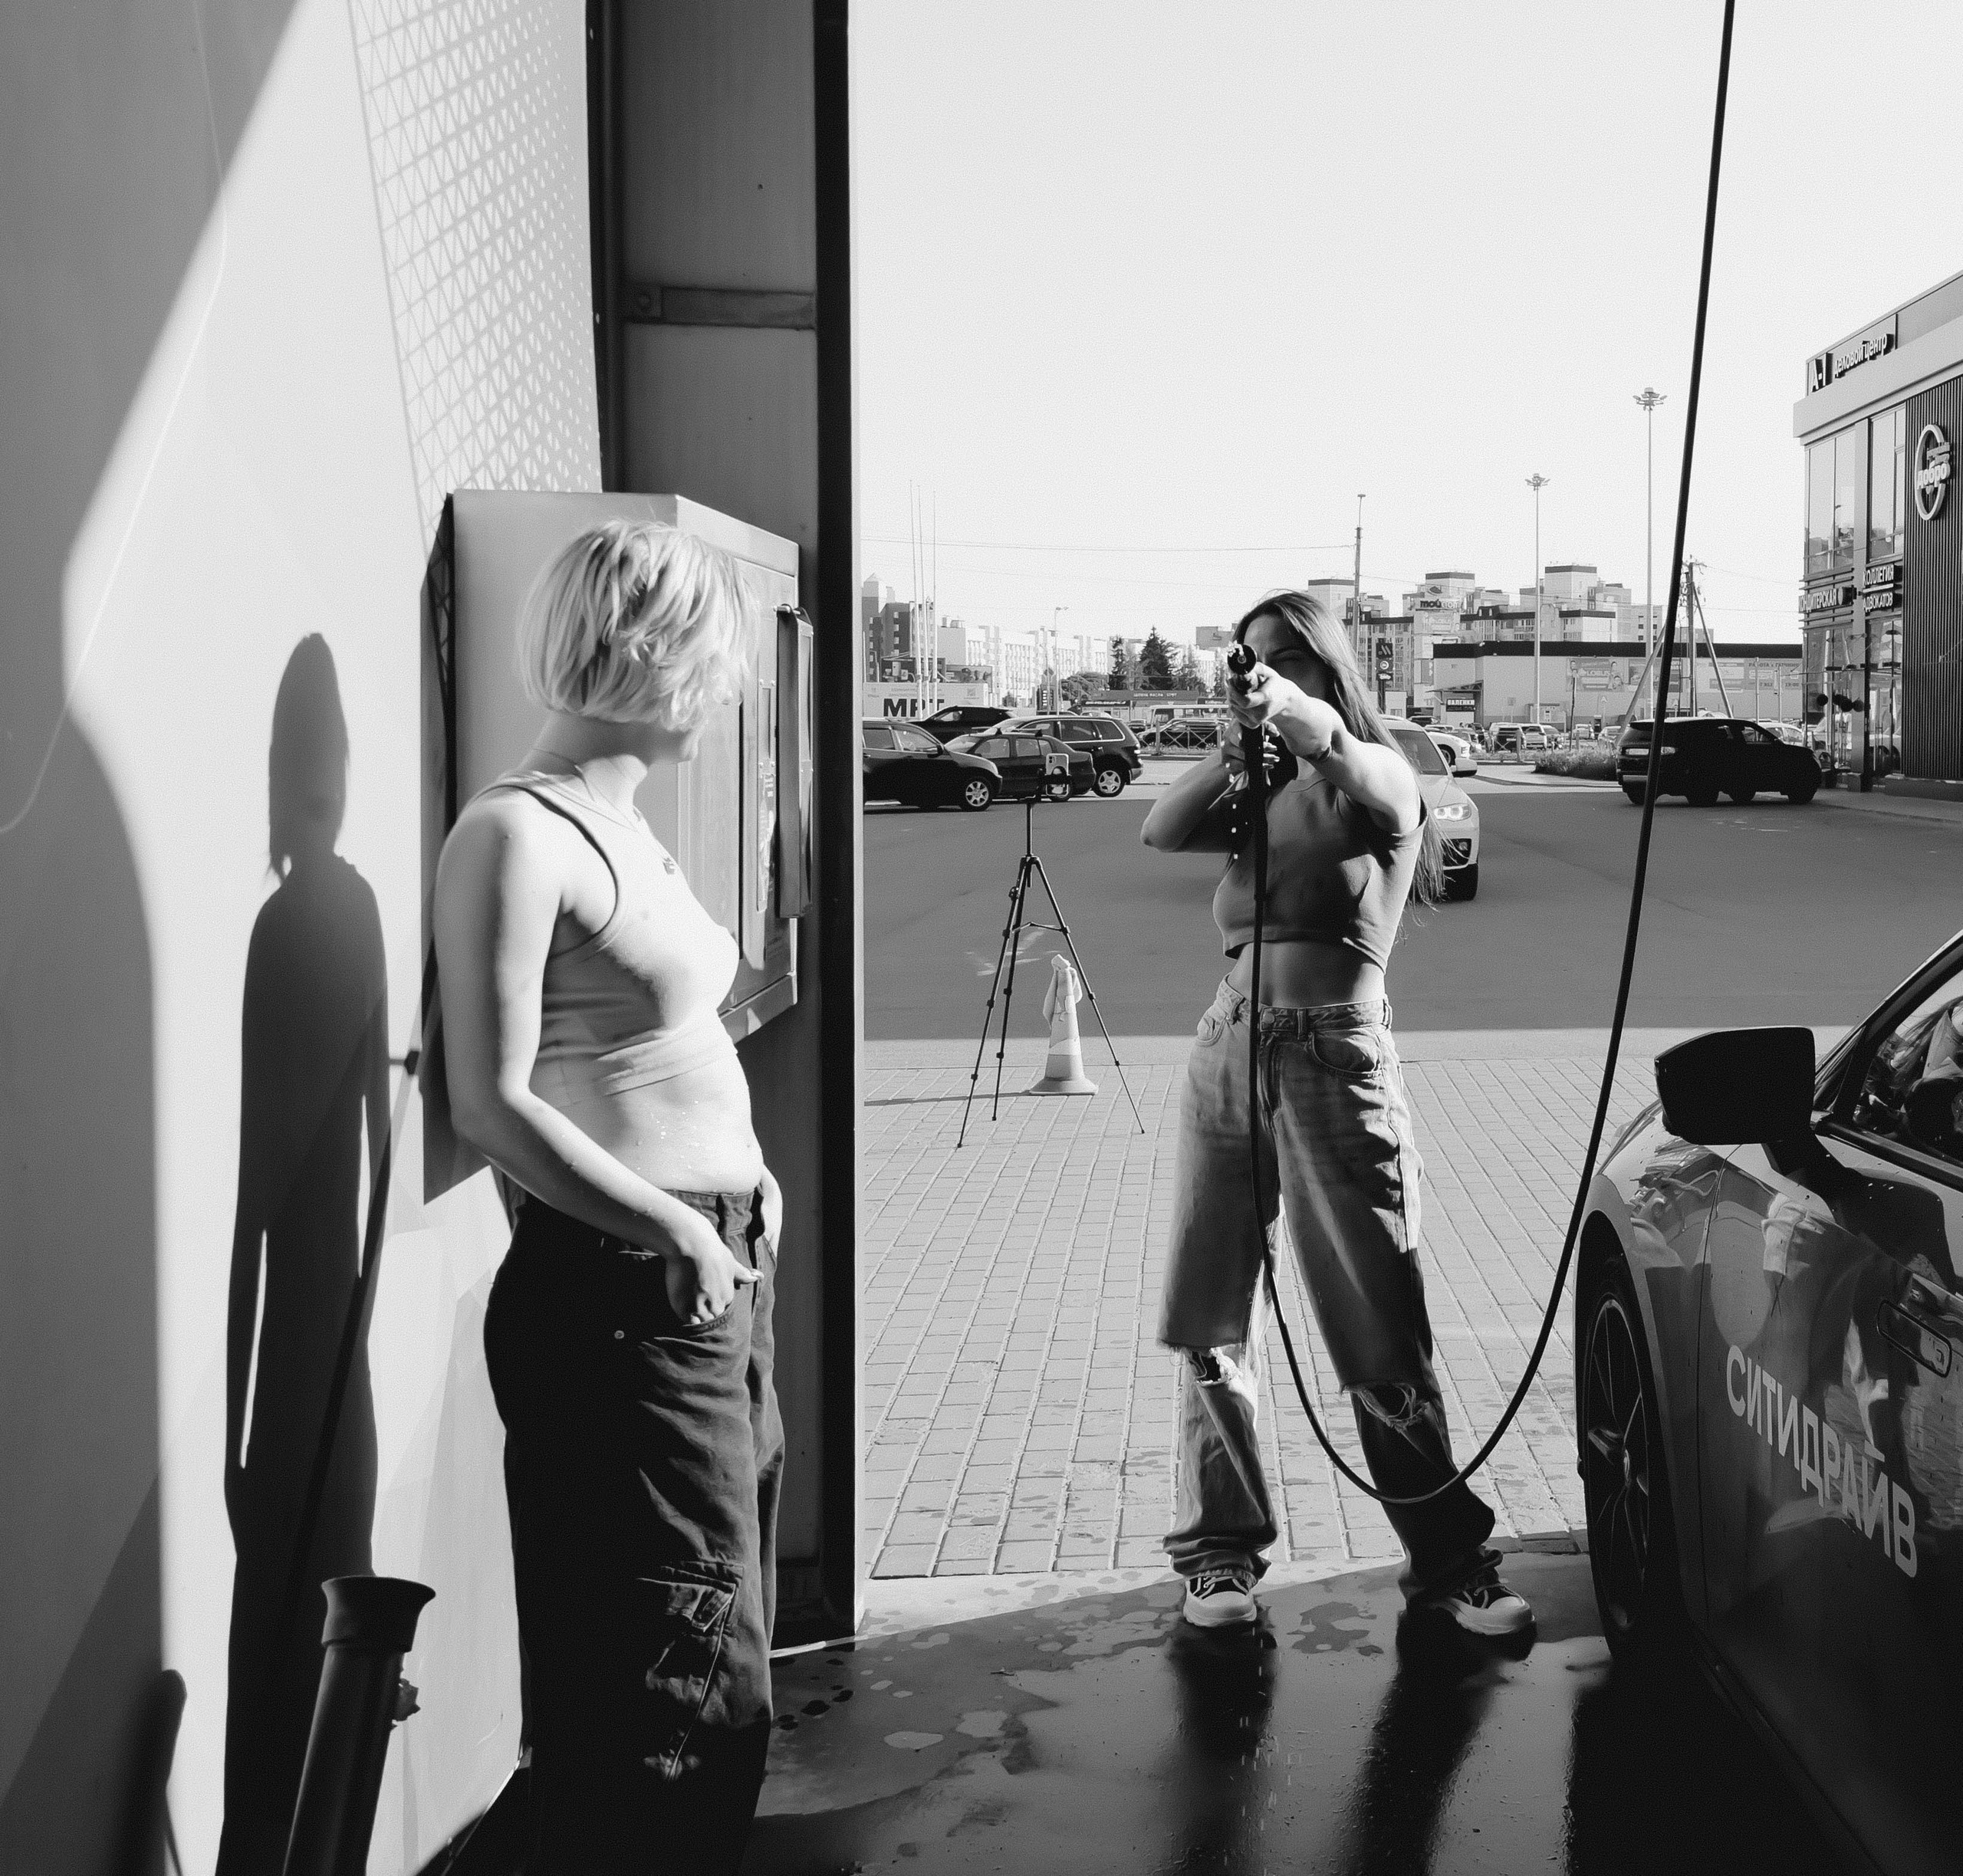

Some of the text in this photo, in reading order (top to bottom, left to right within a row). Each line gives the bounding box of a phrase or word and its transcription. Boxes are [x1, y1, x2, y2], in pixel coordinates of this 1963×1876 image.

[1864, 333, 1887, 360] центр
[1917, 463, 1949, 490] добро
[1863, 564, 1894, 585] КОЛЛЕГИЯ
[1863, 592, 1893, 613] АДВОКАТОВ
[1726, 1345, 1919, 1578] СИТИДРАЙВ
